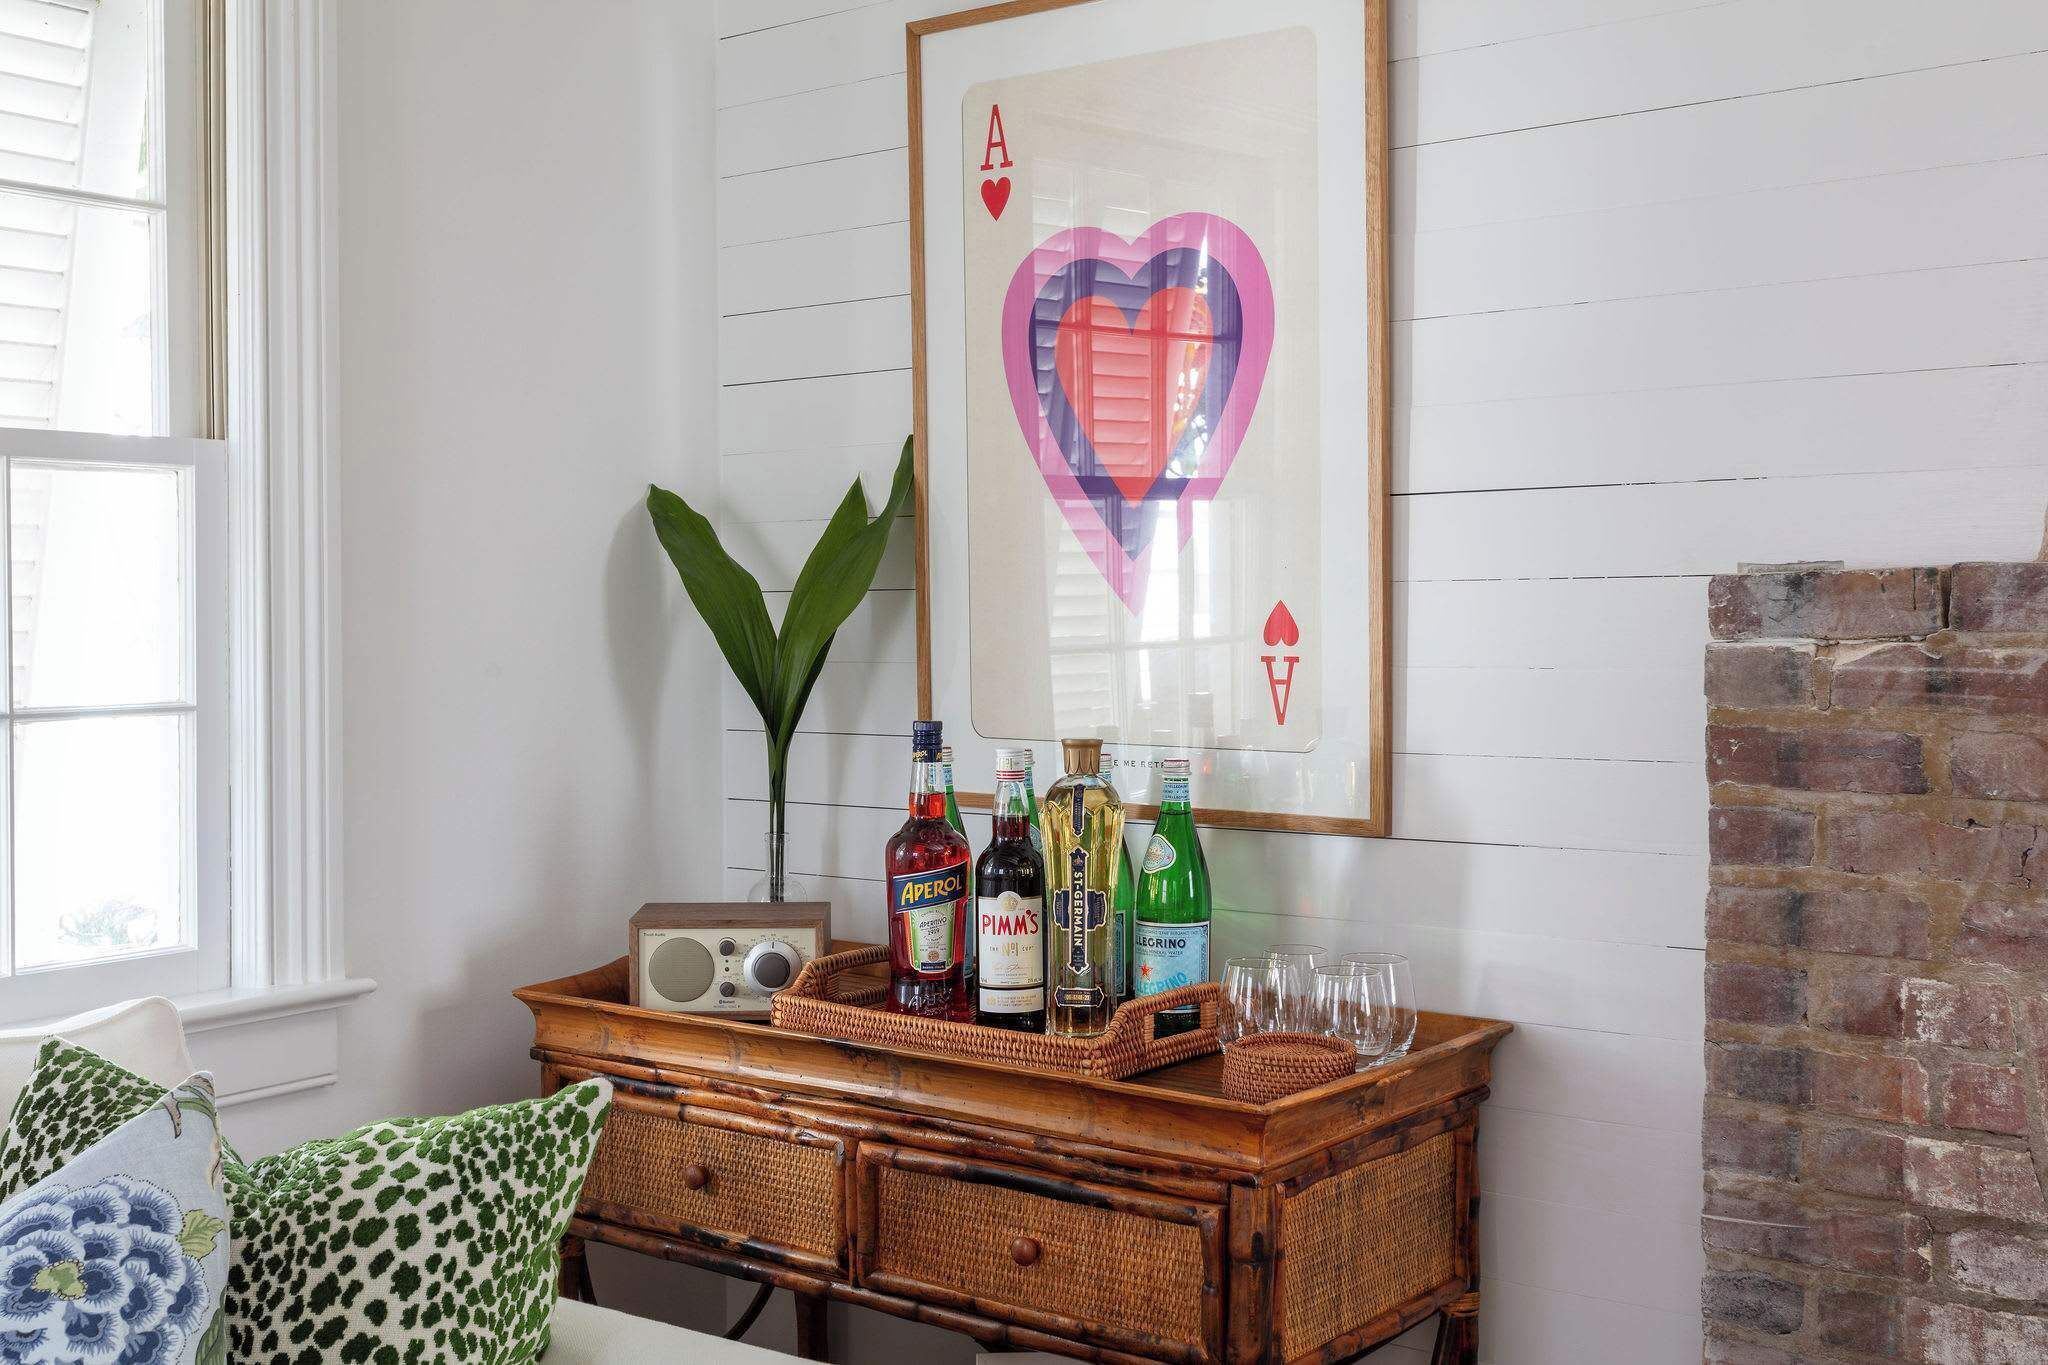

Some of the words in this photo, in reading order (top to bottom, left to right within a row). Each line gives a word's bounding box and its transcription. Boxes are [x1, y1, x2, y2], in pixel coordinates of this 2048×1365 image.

[981, 104, 1013, 171] A
[1261, 656, 1299, 725] A
[1123, 760, 1136, 768] ME
[901, 875, 962, 905] APEROL
[1074, 871, 1083, 946] ST-GERMAIN
[982, 909, 1039, 936] PIMM'S
